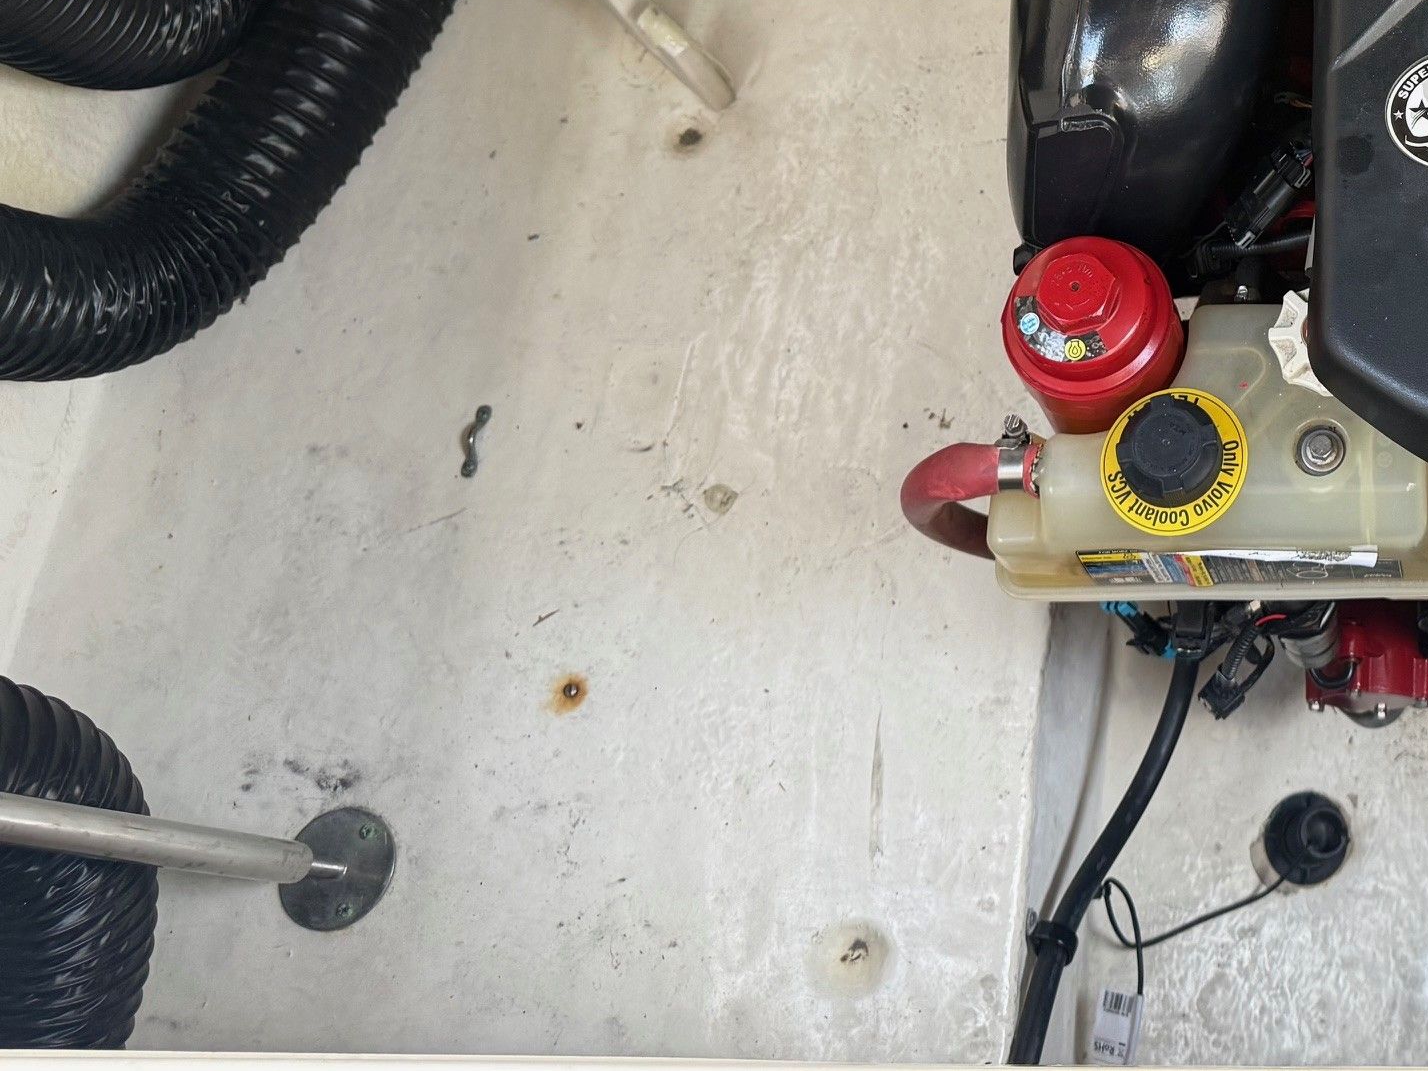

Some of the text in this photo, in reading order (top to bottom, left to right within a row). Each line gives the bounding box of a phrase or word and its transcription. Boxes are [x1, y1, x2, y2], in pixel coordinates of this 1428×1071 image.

[1108, 440, 1239, 526] Only Volvo Coolant VCS
